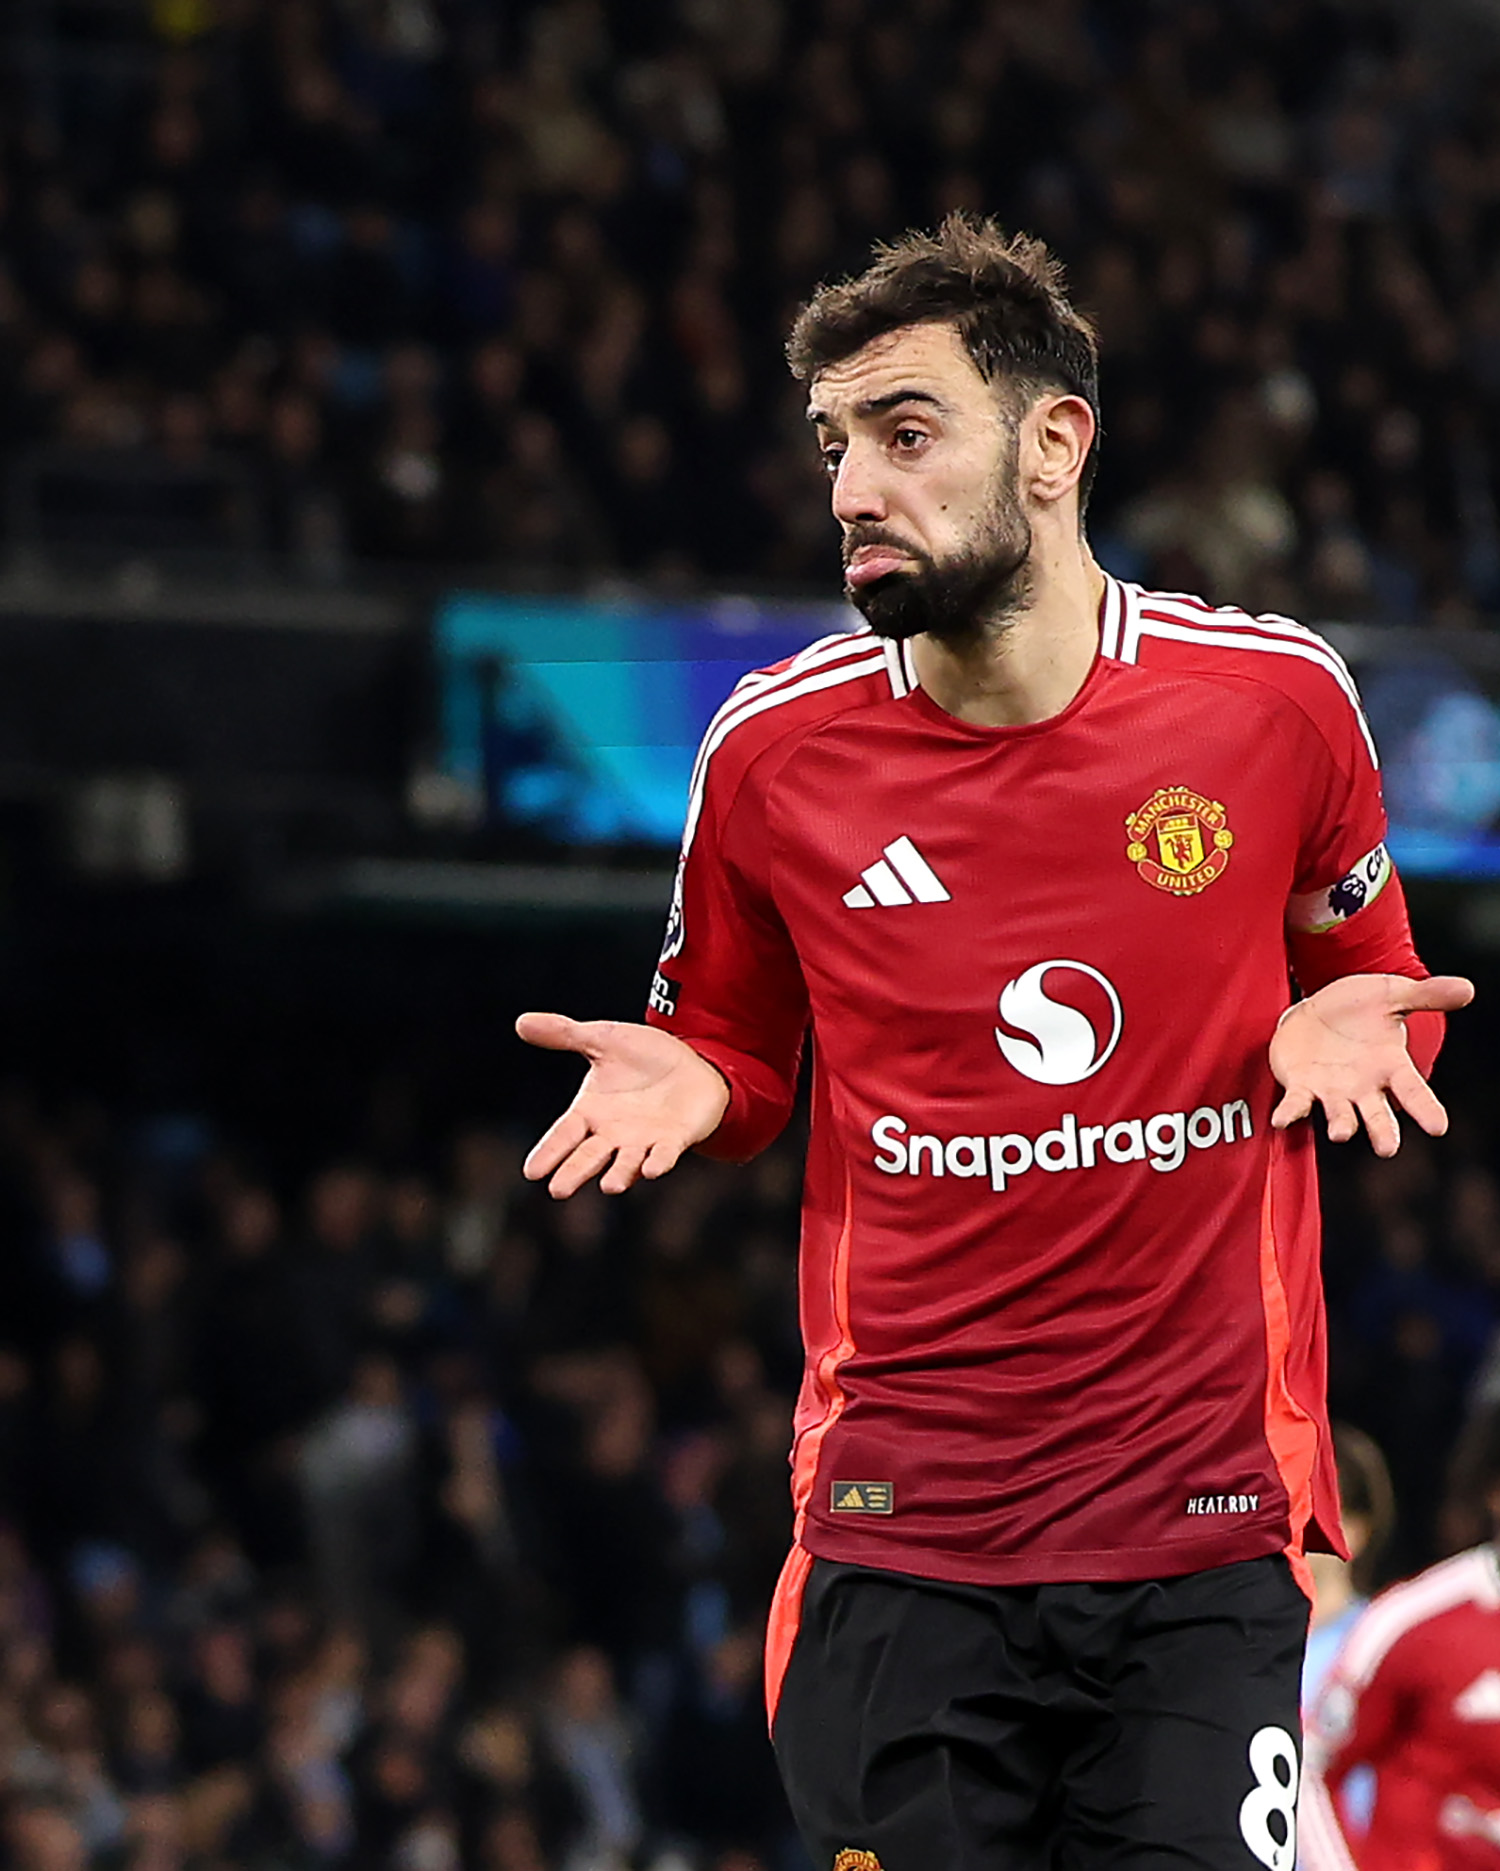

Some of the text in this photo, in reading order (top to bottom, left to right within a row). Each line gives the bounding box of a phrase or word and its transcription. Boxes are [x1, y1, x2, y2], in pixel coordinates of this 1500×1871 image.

[1134, 795, 1220, 835] MANCHESTER
[1156, 865, 1216, 888] UNITED
[871, 1098, 1254, 1192] Snapdragon
[1186, 1494, 1259, 1515] HEAT.RDY
[1239, 1725, 1298, 1871] 8
